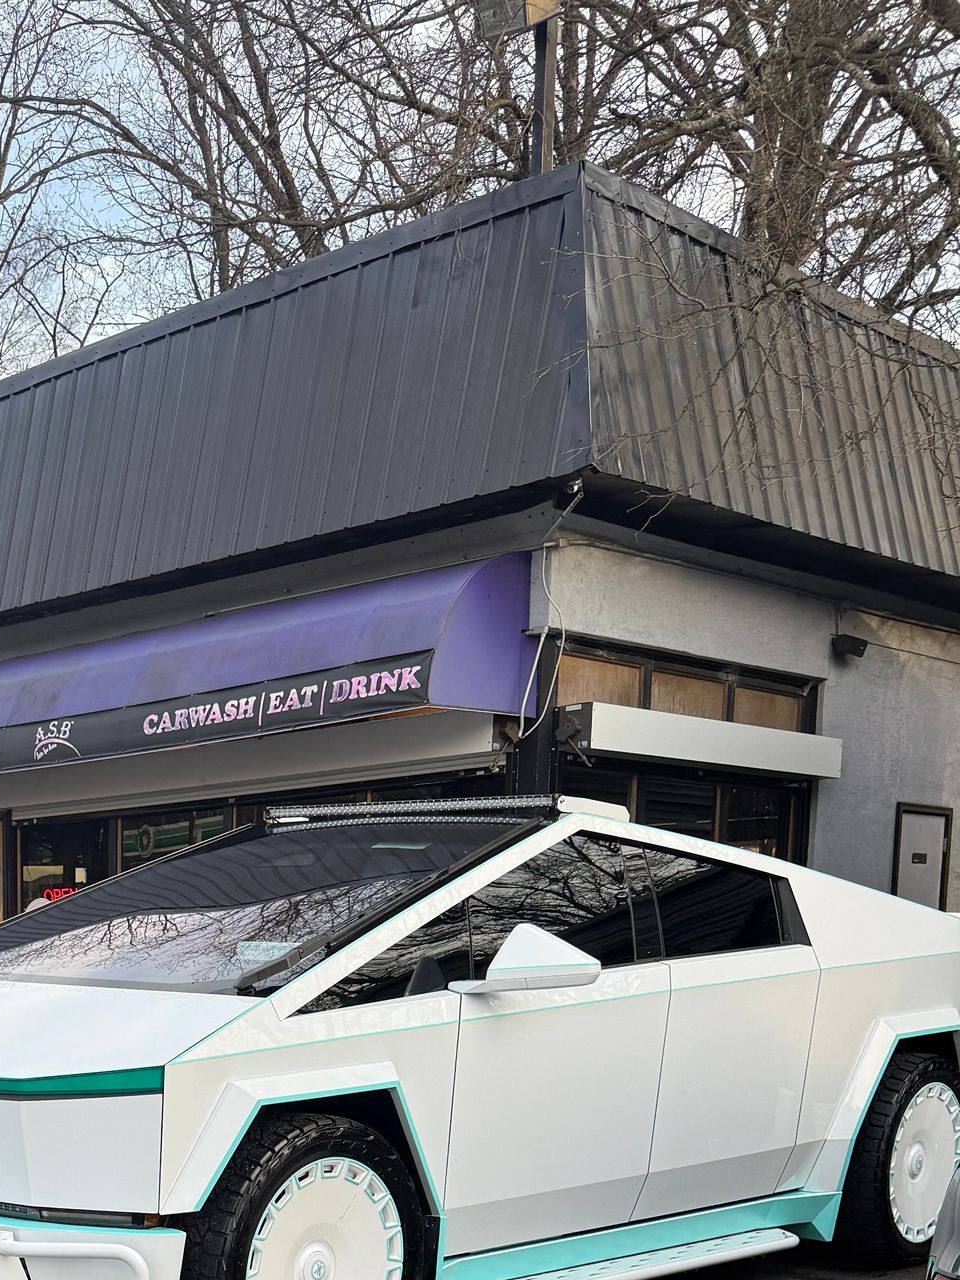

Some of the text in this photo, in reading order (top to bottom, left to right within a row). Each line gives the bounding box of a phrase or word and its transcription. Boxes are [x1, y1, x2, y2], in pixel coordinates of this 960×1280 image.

[143, 666, 421, 735] CARWASH EAT DRINK
[43, 888, 78, 902] OP
